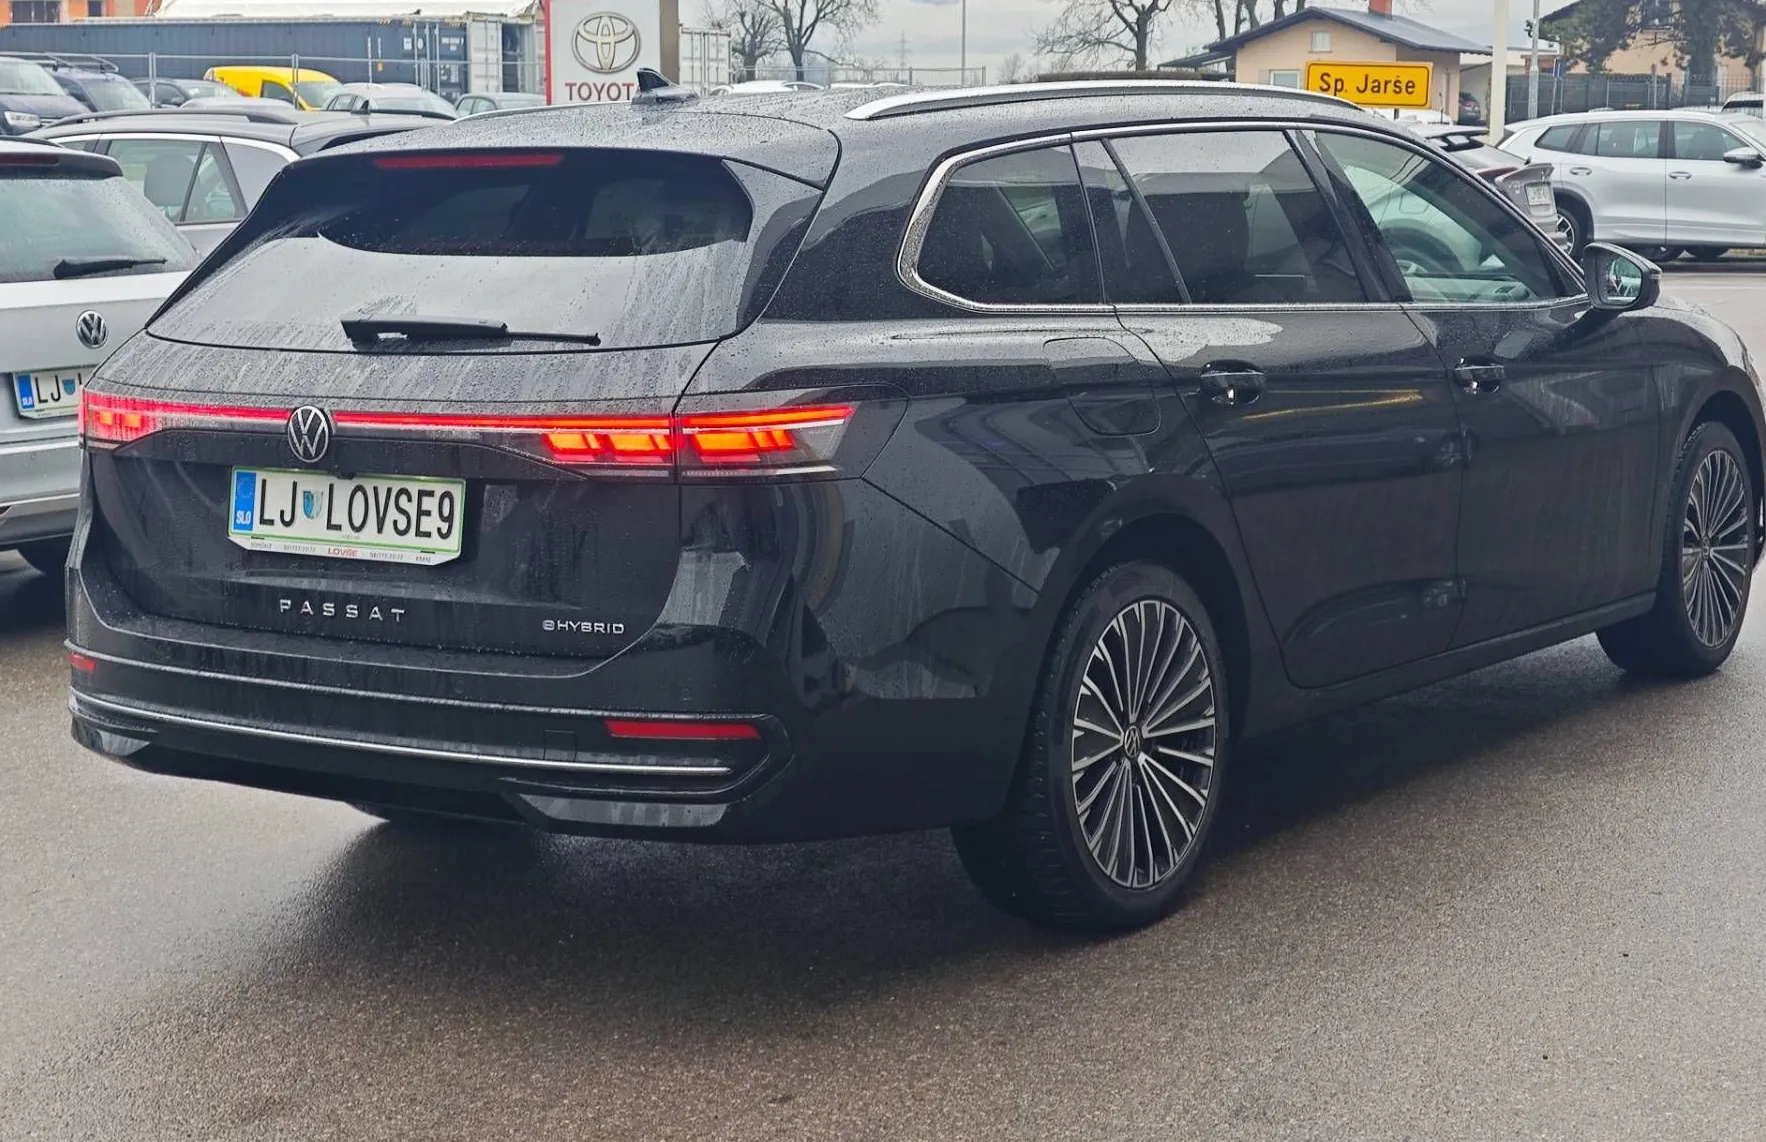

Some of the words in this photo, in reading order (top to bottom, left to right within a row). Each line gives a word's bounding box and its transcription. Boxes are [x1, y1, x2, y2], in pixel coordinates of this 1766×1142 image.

[565, 82, 640, 101] TOYOT
[1319, 72, 1348, 96] Sp.
[1356, 74, 1416, 95] Jarše
[35, 375, 61, 404] LJ
[236, 510, 252, 525] SLO
[259, 478, 298, 527] LJ
[326, 483, 455, 540] LOVSE9
[280, 599, 405, 623] PASSAT
